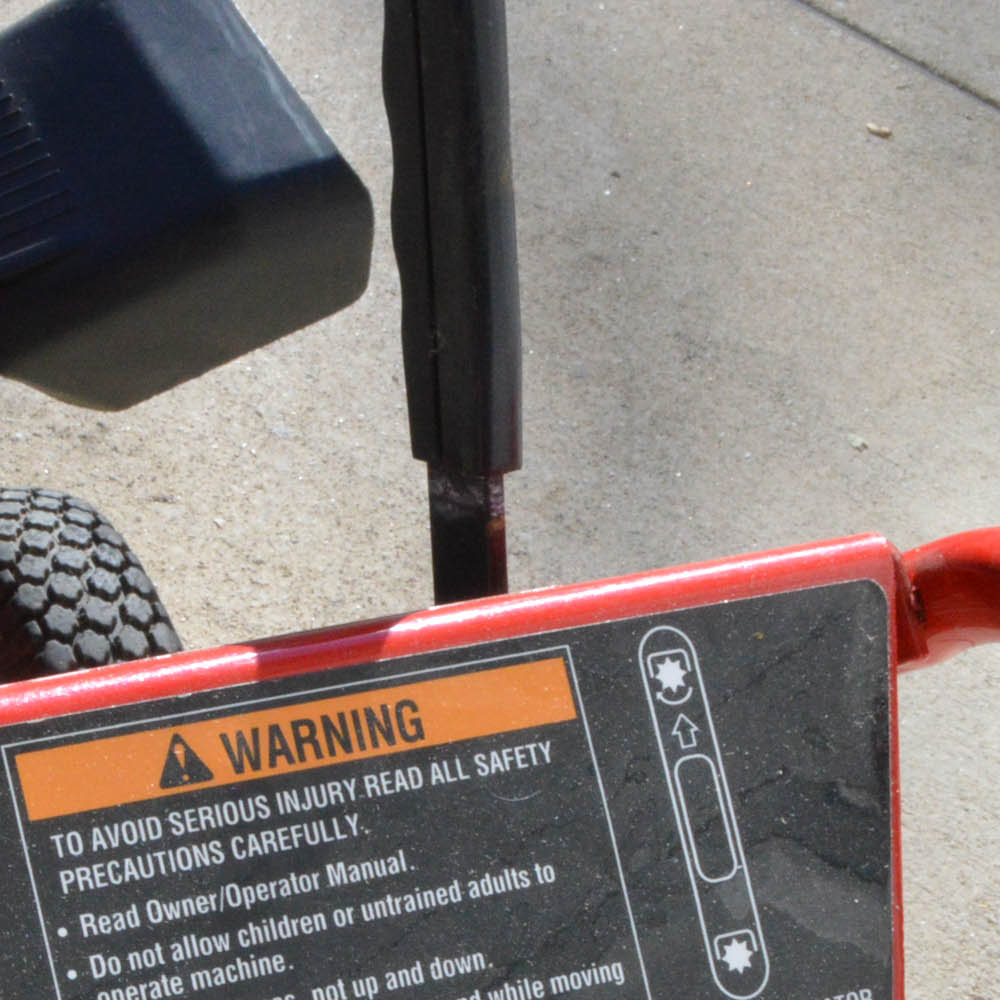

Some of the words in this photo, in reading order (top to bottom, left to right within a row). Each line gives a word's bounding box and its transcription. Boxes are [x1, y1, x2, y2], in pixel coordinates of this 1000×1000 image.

[218, 698, 425, 775] WARNING
[50, 831, 84, 859] TO
[92, 816, 163, 852] AVOID
[168, 794, 271, 836] SERIOUS
[275, 777, 356, 815] INJURY
[362, 765, 424, 799] READ
[430, 757, 471, 786] ALL
[473, 740, 551, 777] SAFETY
[58, 839, 226, 895] PRECAUTIONS
[78, 903, 141, 938] Read
[145, 871, 320, 924] Owner/Operator
[325, 848, 416, 888] Manual.
[88, 953, 122, 980] Do
[126, 942, 166, 972] not
[169, 932, 230, 963] allow
[237, 912, 328, 948] children
[332, 906, 355, 928] or
[360, 879, 463, 922] untrained
[467, 867, 532, 900] adults
[533, 862, 556, 885] to
[189, 953, 294, 991] machine.
[351, 975, 379, 1000] up
[384, 960, 425, 991] and
[429, 951, 494, 981] down.
[549, 961, 626, 995] moving
